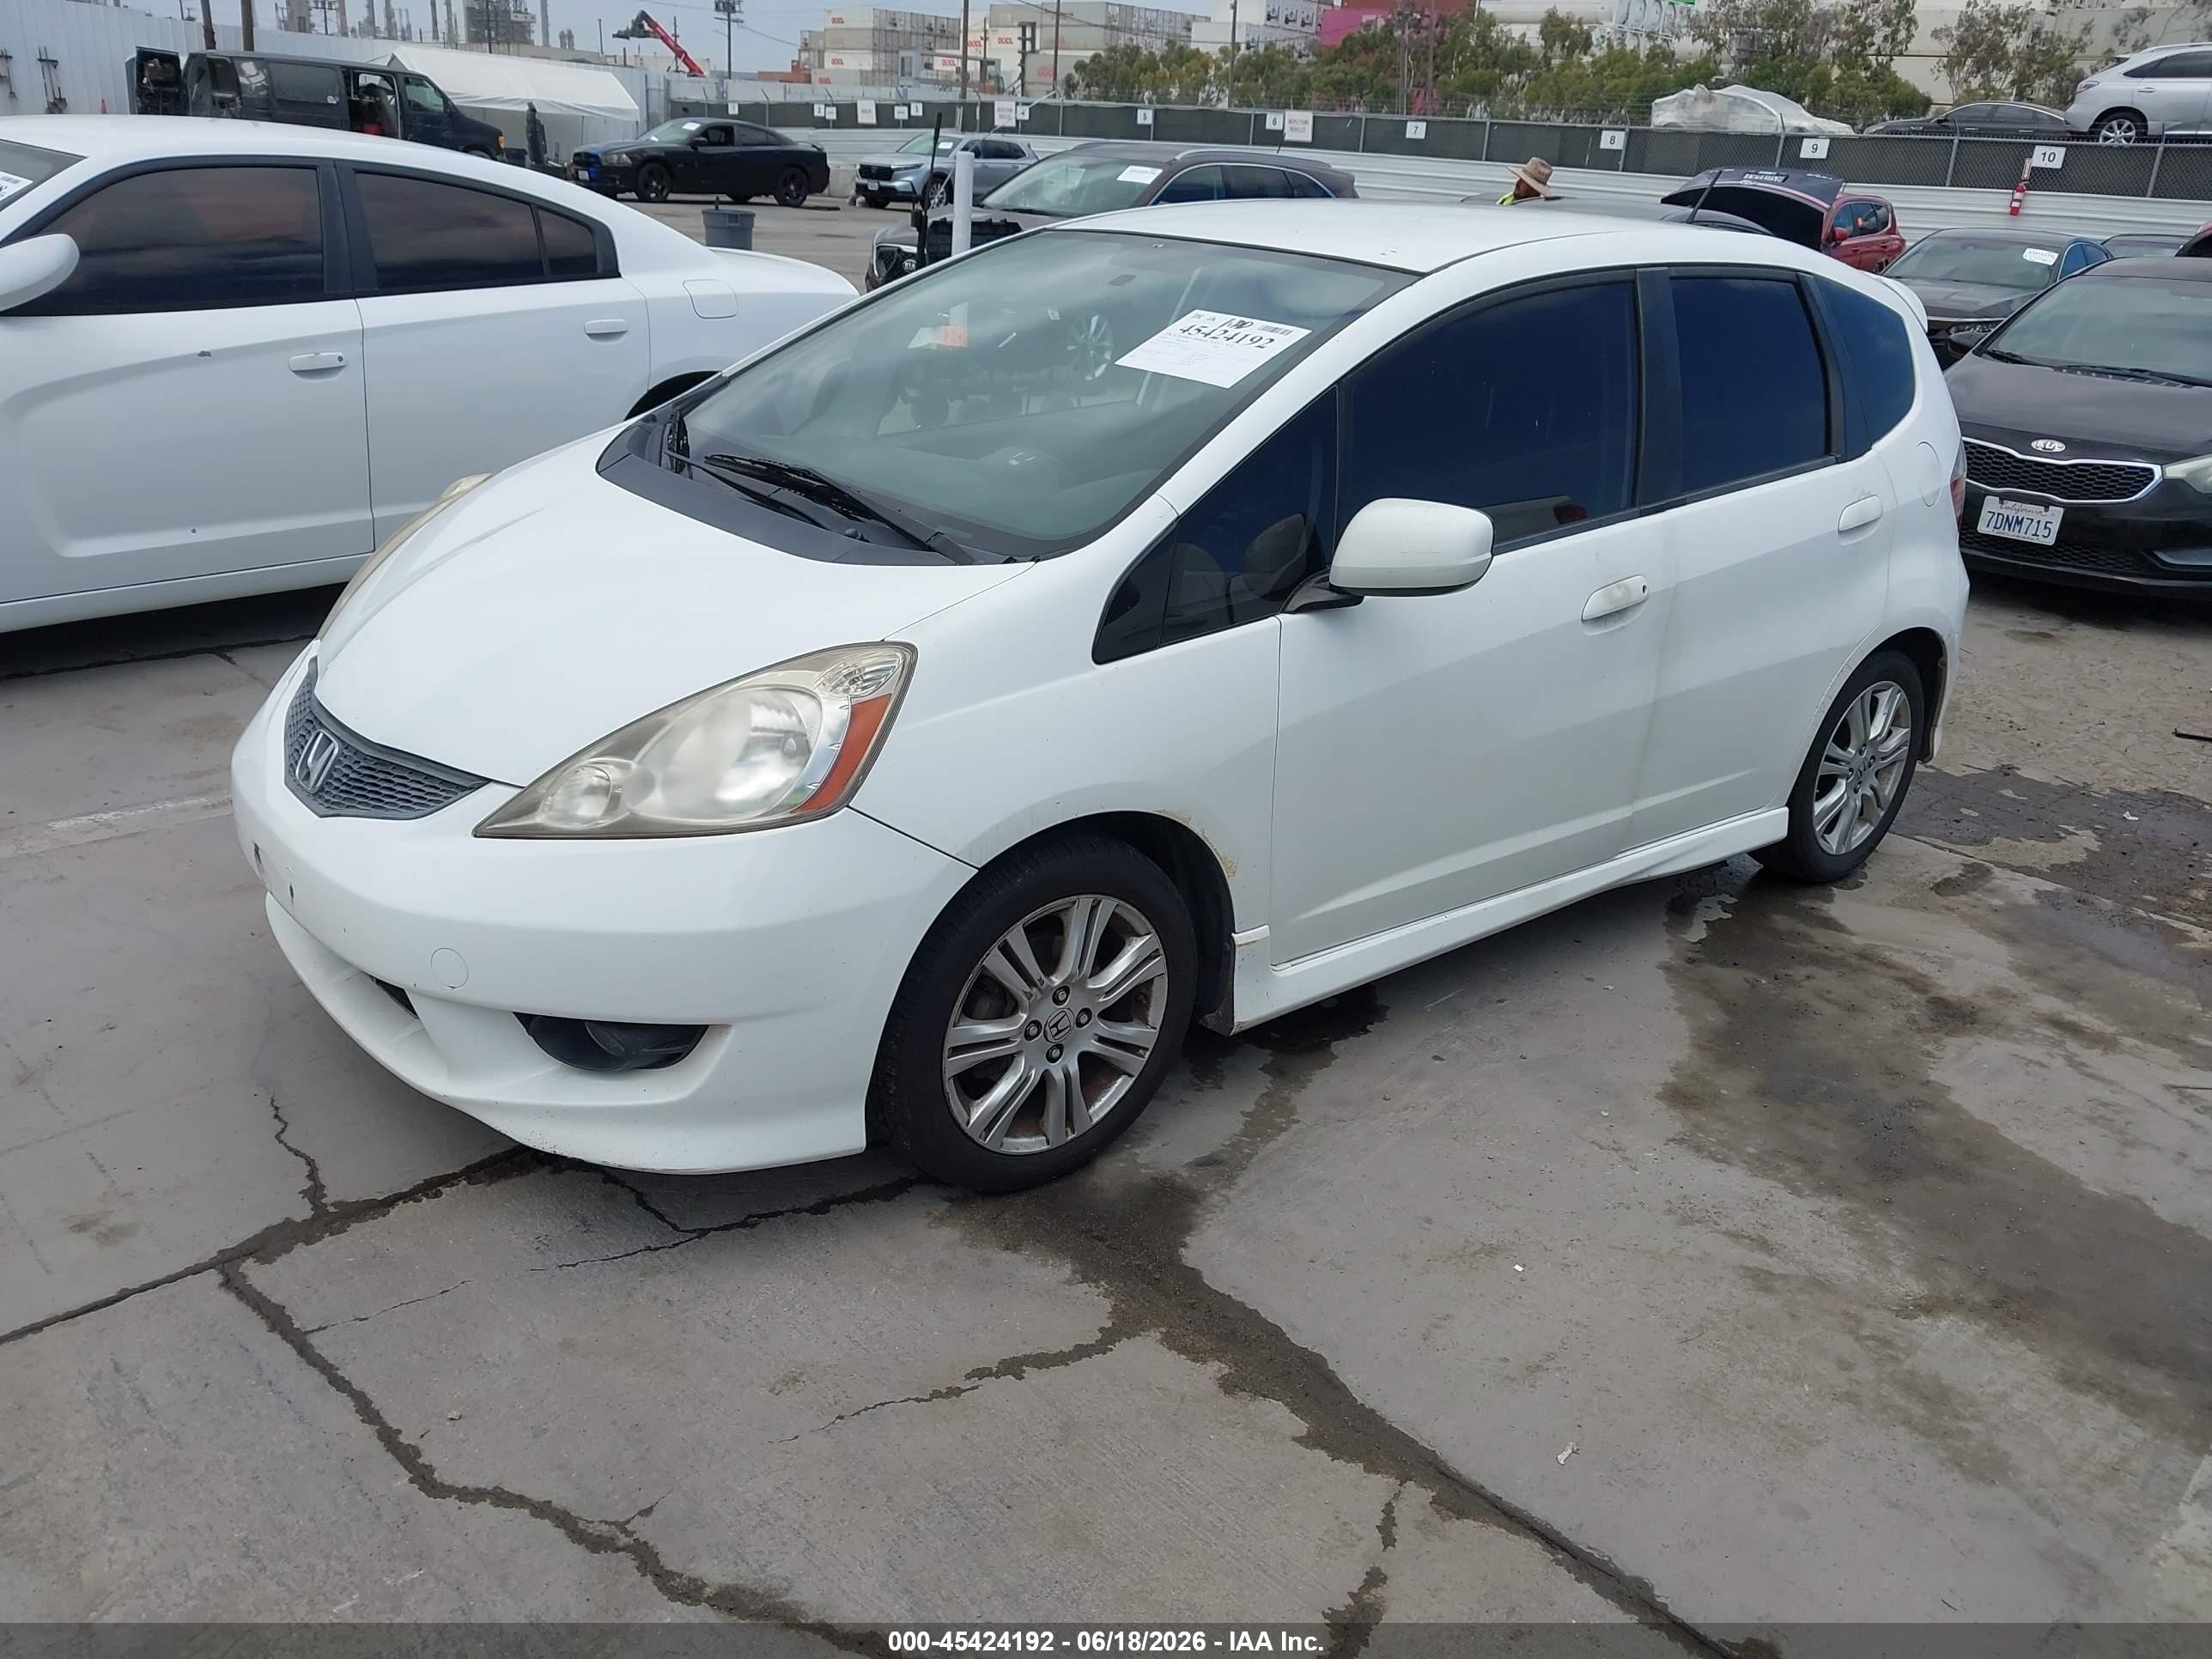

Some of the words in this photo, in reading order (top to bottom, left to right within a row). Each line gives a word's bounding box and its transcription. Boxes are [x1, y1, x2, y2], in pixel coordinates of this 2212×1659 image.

[1609, 135, 1616, 145] 8
[1811, 143, 1819, 154] 9
[2040, 151, 2057, 162] 10
[1179, 323, 1275, 349] 45424192
[2036, 440, 2063, 452] KIA
[1985, 510, 2053, 538] 7DNM715
